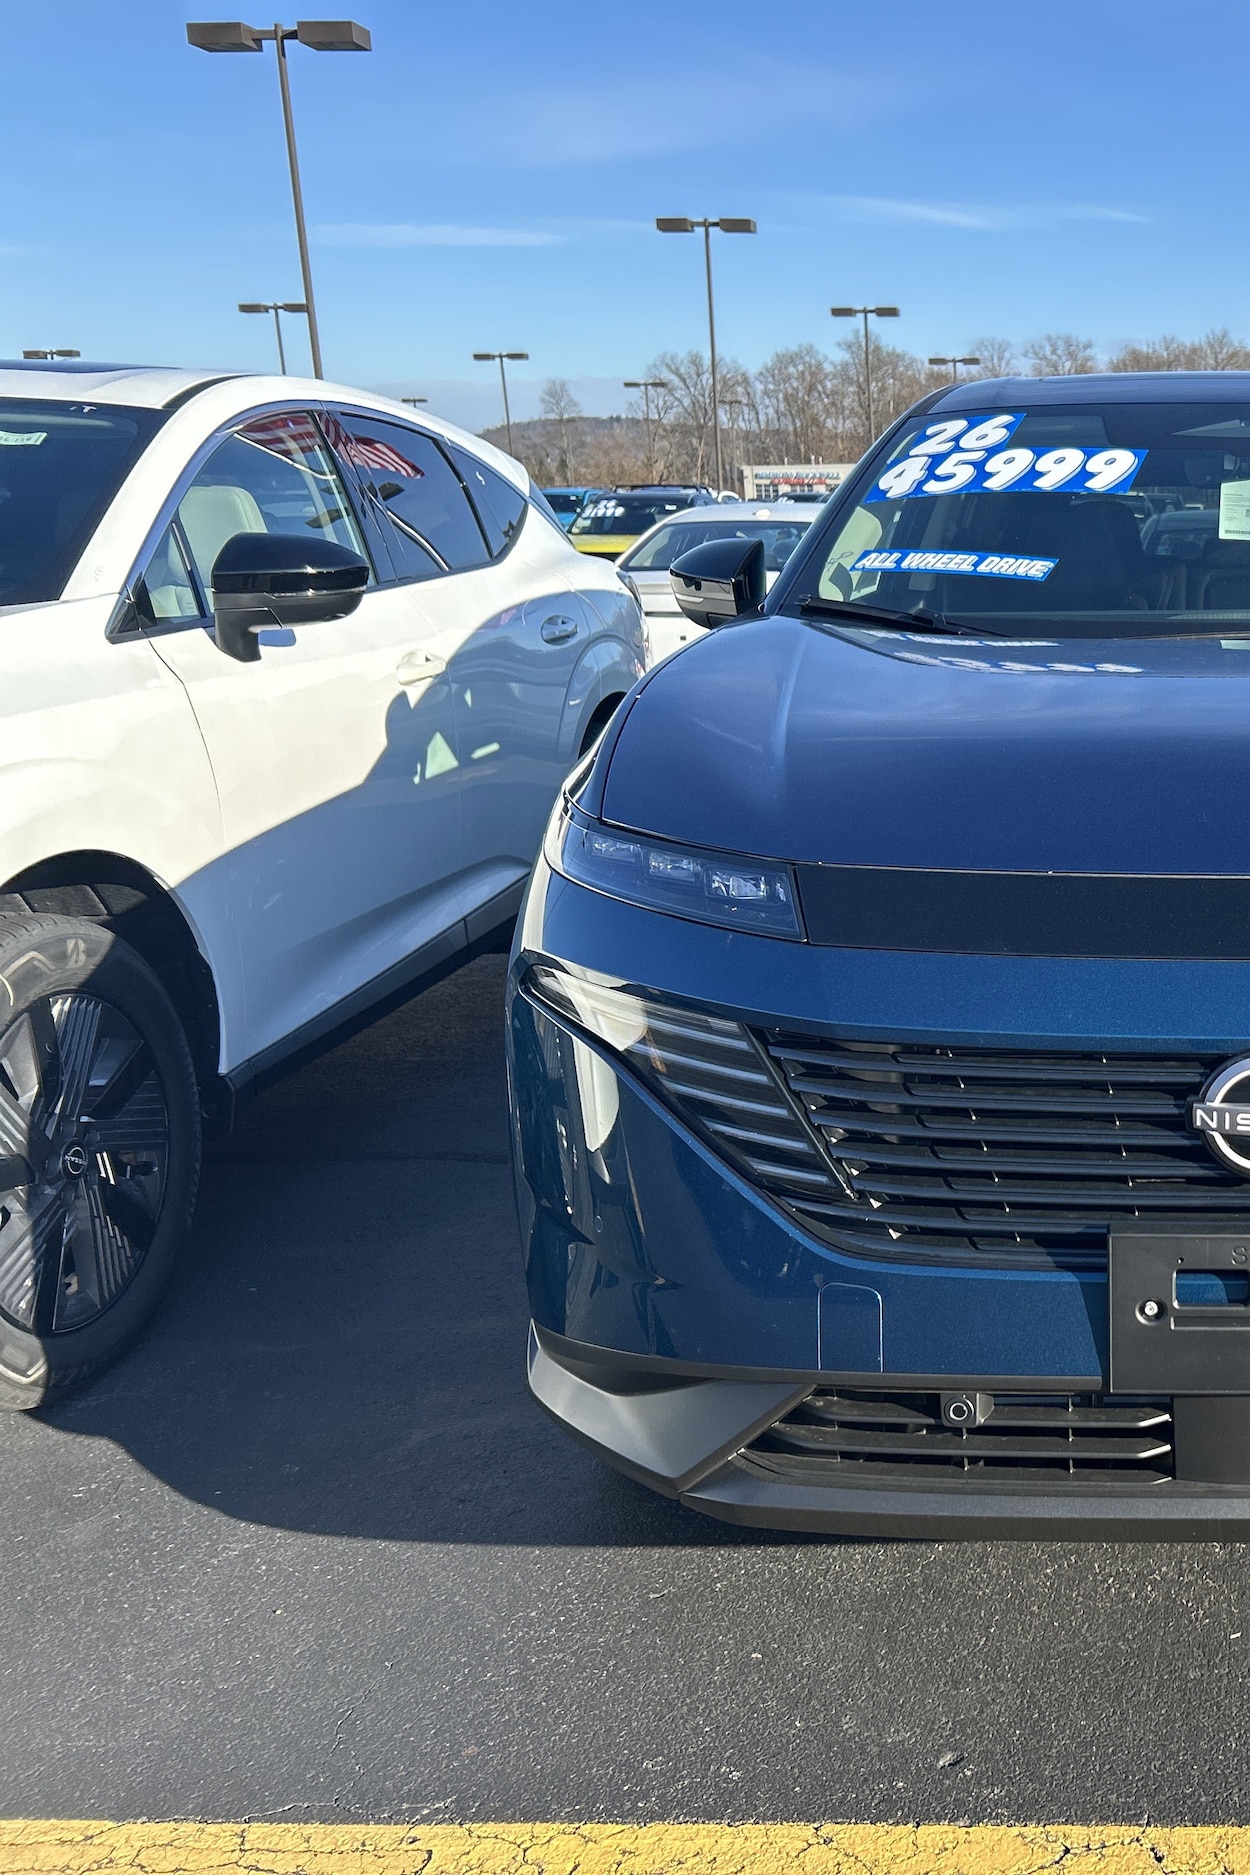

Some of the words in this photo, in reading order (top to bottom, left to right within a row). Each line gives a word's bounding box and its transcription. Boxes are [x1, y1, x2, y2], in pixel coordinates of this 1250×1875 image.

[908, 414, 1017, 457] 26
[878, 448, 1139, 498] 45999
[855, 552, 902, 569] ALL
[900, 553, 979, 571] WHEEL
[976, 556, 1054, 578] DRIVE
